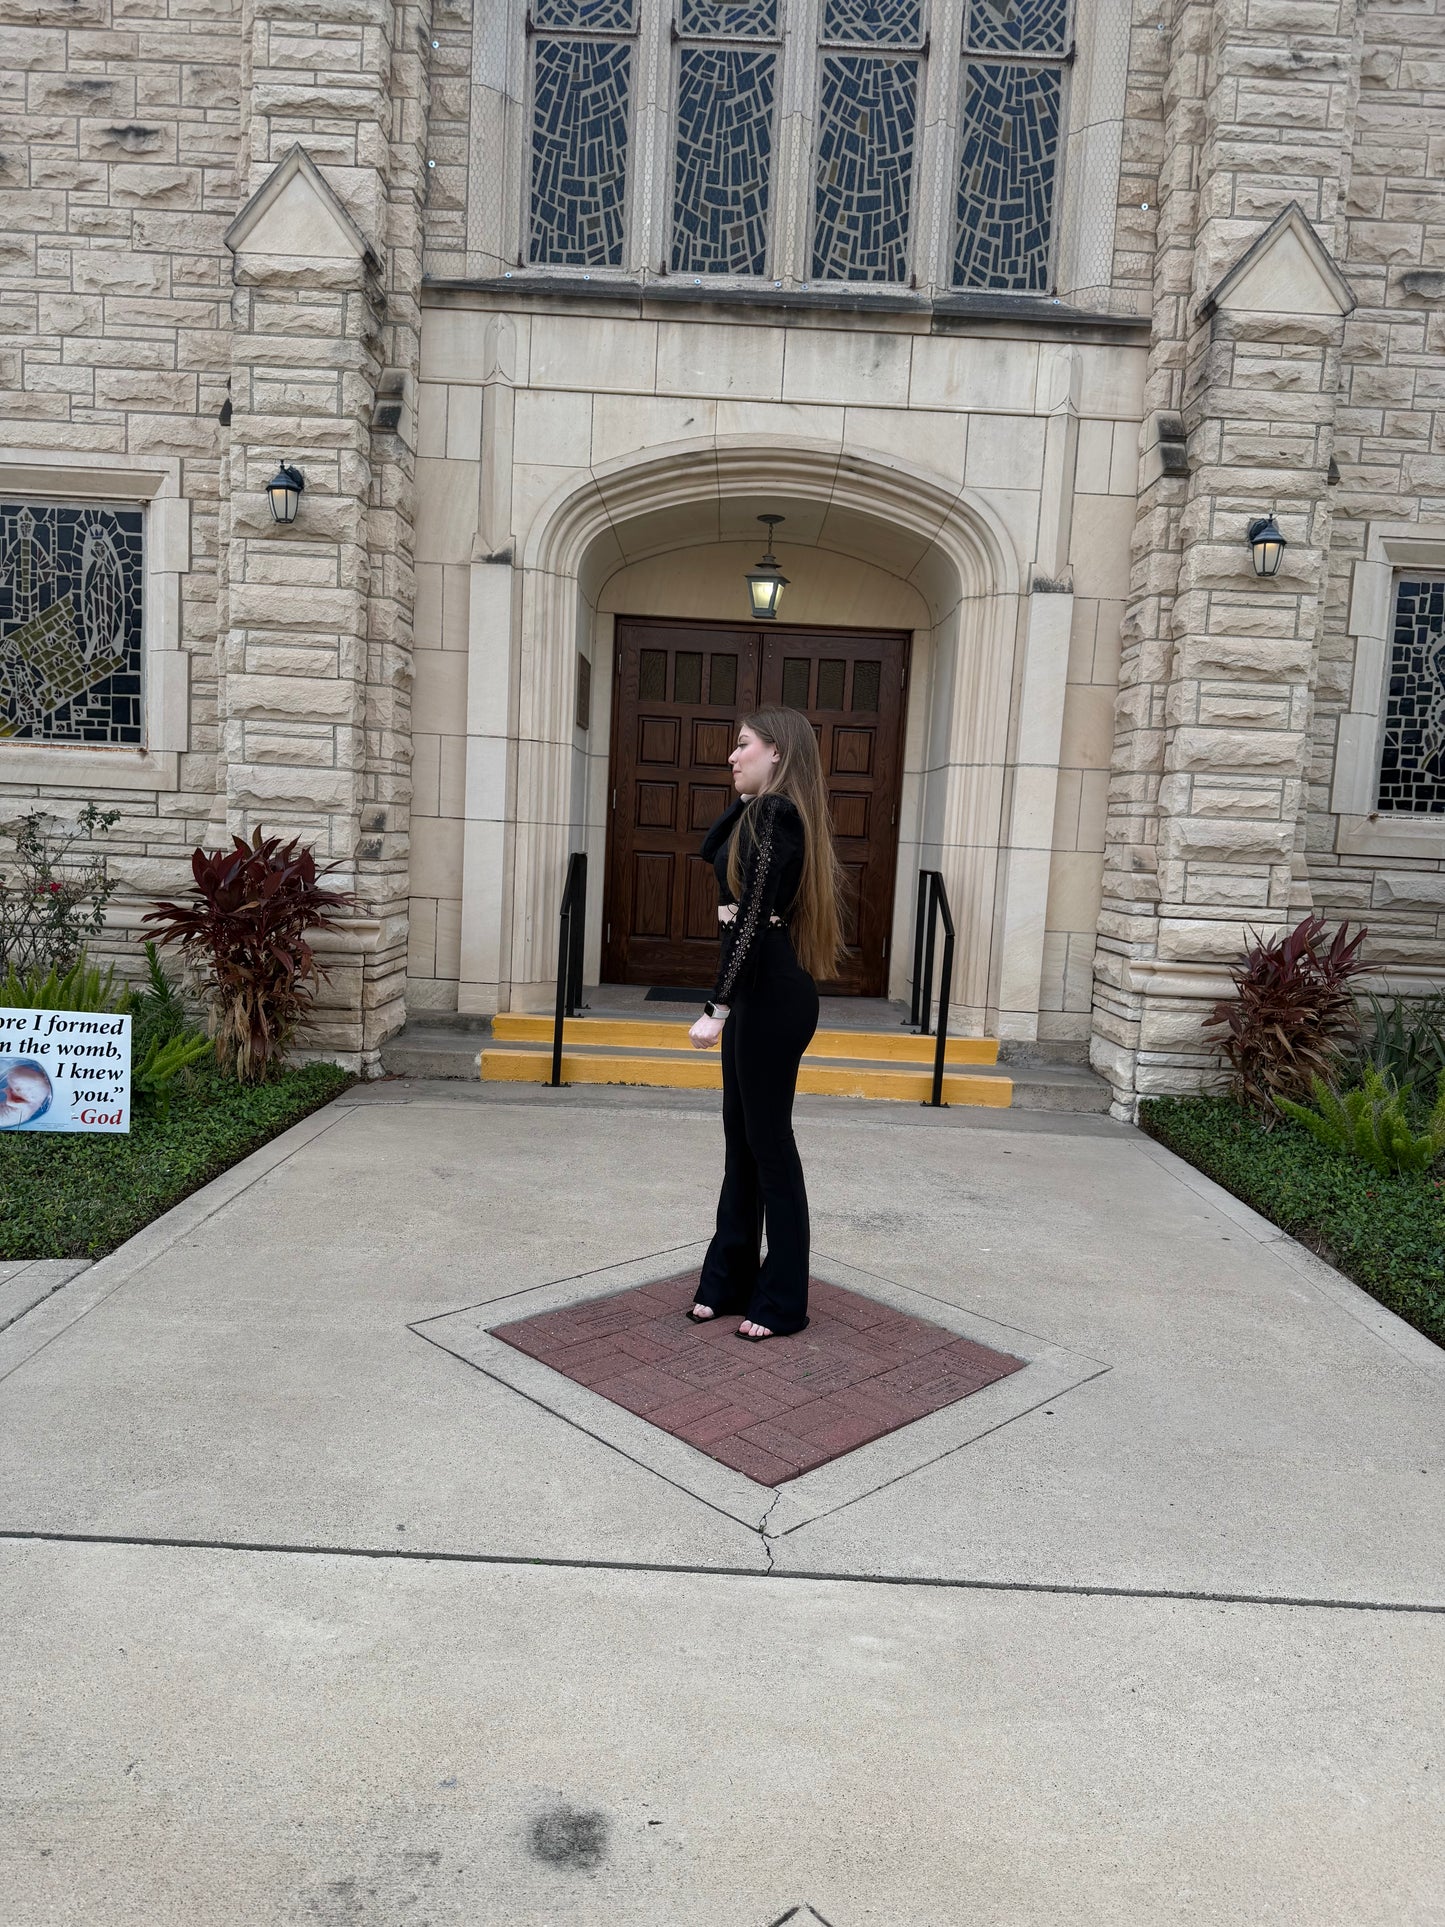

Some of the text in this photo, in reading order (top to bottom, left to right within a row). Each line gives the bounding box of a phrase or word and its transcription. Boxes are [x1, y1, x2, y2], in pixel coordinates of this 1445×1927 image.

[32, 1014, 43, 1031] I
[44, 1014, 124, 1036] formed
[19, 1037, 51, 1054] the
[57, 1041, 122, 1061] womb,
[56, 1063, 124, 1081] I knew
[72, 1109, 123, 1125] -God
